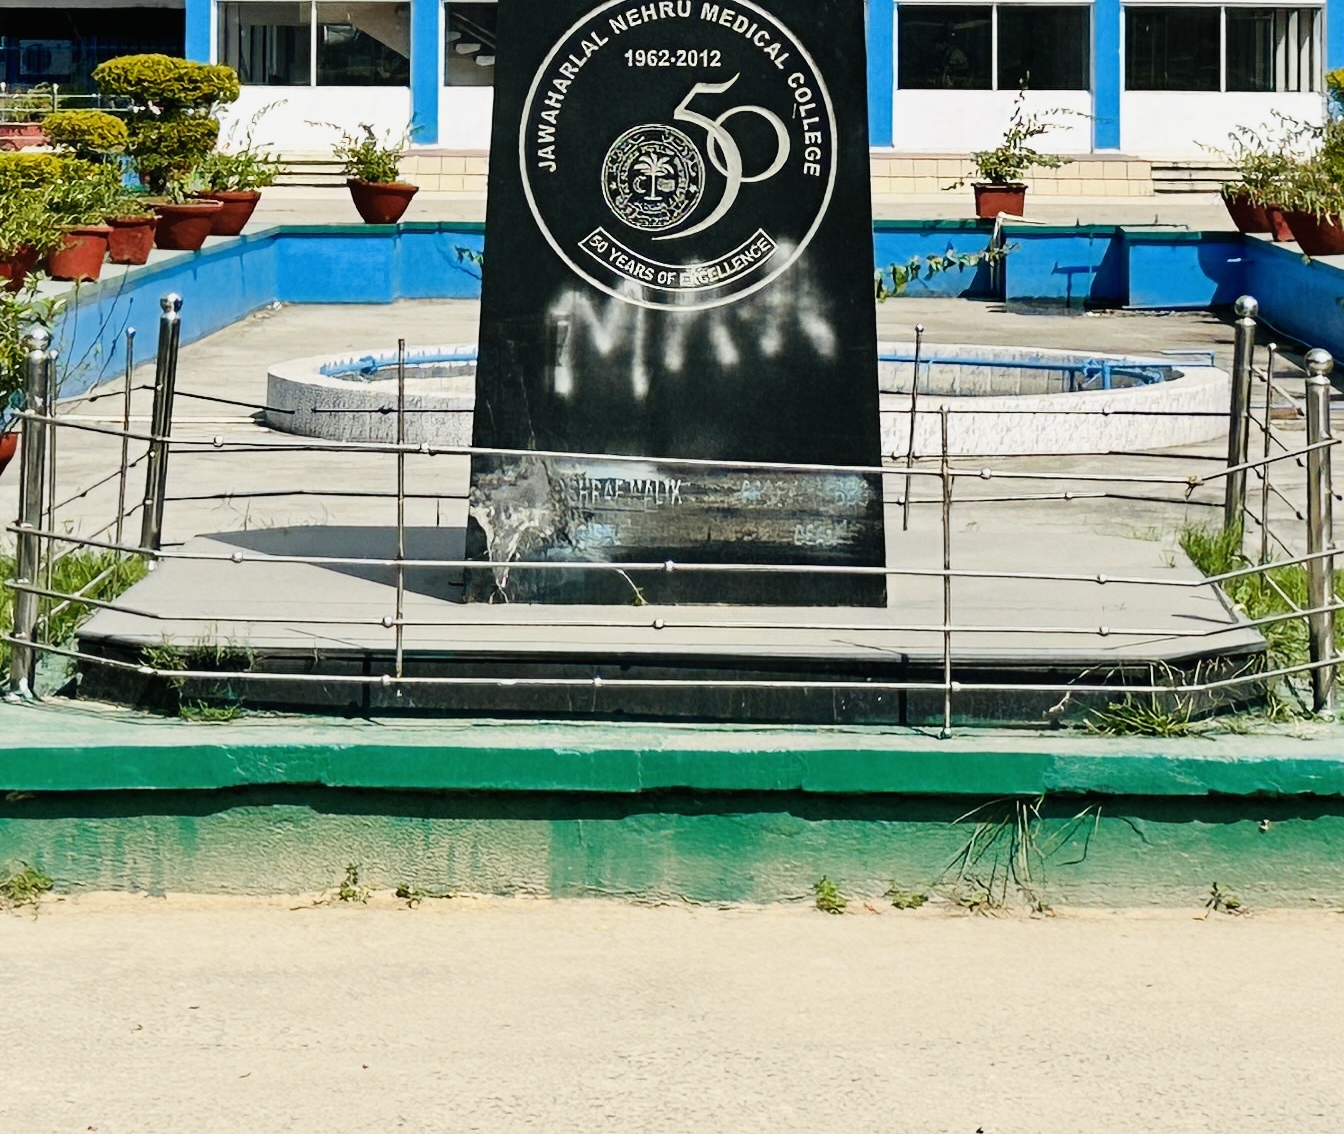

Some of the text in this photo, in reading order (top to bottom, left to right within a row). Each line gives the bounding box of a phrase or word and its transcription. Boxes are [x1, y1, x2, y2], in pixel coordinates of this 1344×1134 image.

[537, 30, 610, 172] JAWAHARLAL
[609, 0, 692, 35] NEHRU
[700, 1, 792, 70] MEDICAL
[787, 71, 823, 178] COLLEGE
[651, 71, 791, 241] 50
[588, 234, 608, 254] 50
[609, 247, 655, 282] YEARS
[657, 270, 677, 285] OF
